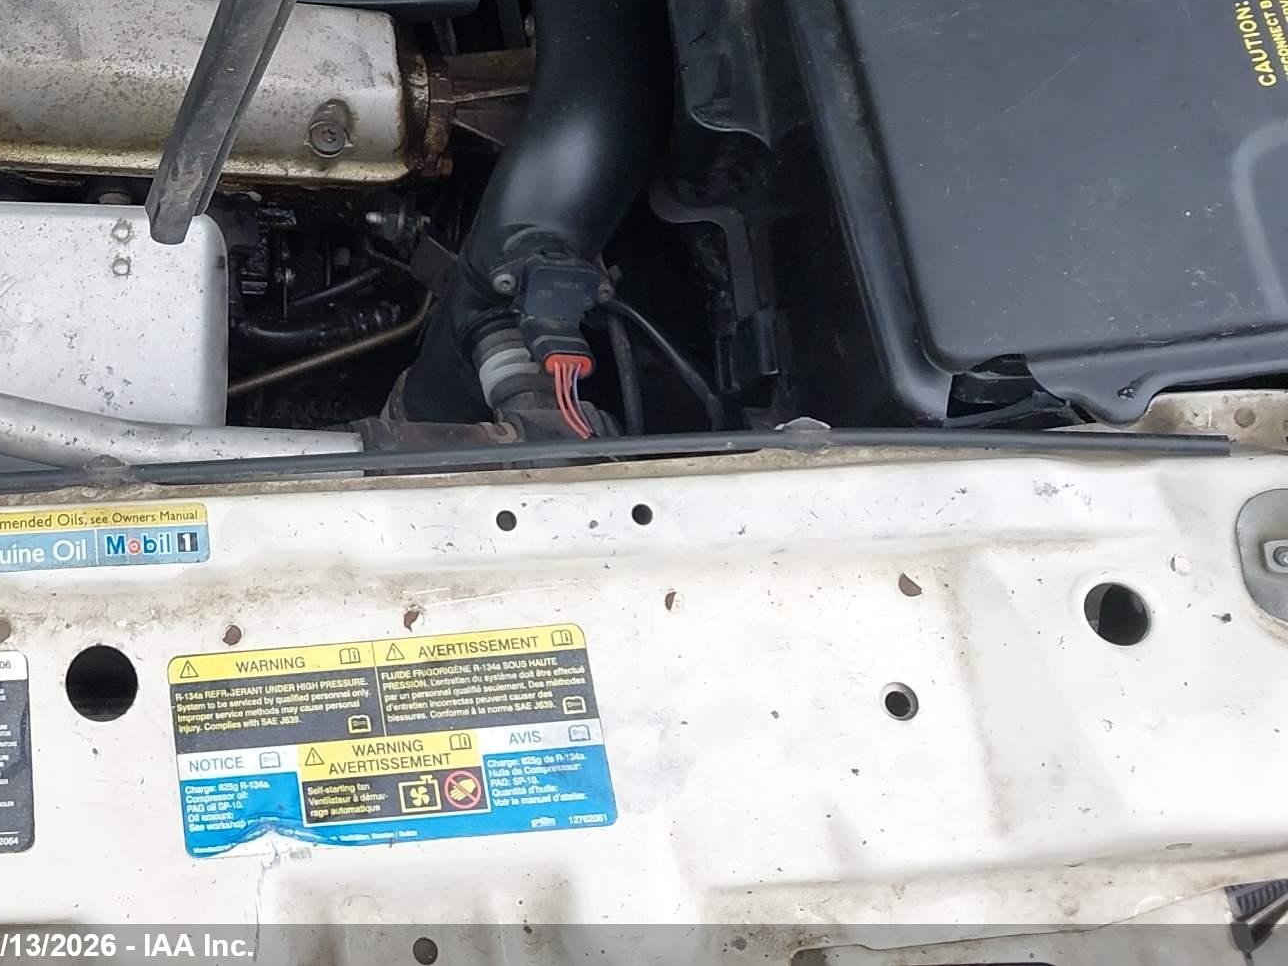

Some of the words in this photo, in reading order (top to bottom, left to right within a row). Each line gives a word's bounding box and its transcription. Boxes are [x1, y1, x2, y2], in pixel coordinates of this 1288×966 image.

[1234, 0, 1277, 86] CAUTION:
[1263, 11, 1288, 77] CONNECT
[57, 512, 89, 527] Oils,
[90, 515, 108, 525] see
[112, 512, 156, 523] Owners
[160, 509, 198, 521] Manual
[53, 539, 87, 561] Oil
[106, 532, 171, 556] Mobil
[179, 533, 195, 552] 1
[418, 636, 539, 658] AVERTISSEMENT
[236, 656, 306, 673] WARNING
[381, 670, 411, 680] FLUIDE
[413, 663, 472, 677] FRIGORIGÈNE
[473, 662, 502, 672] R-134a
[502, 660, 527, 669] SOUS
[528, 657, 558, 667] HAUTE
[472, 675, 482, 683] du
[484, 672, 517, 684] système
[519, 671, 534, 679] doit
[536, 669, 552, 677] être
[554, 666, 585, 676] effectué
[175, 692, 204, 701] R-134a
[265, 684, 295, 693] UNDER
[297, 682, 319, 691] HIGH
[320, 678, 368, 689] PRESSURE.
[385, 695, 398, 703] par
[412, 689, 452, 701] personnel
[528, 680, 545, 688] Des
[546, 677, 586, 687] méthodes
[176, 702, 206, 713] System
[207, 701, 216, 709] to
[229, 698, 262, 707] serviced
[264, 697, 274, 706] by
[275, 694, 310, 706] qualified
[311, 691, 351, 703] personnel
[476, 694, 508, 706] peuvent
[537, 690, 553, 698] des
[215, 710, 244, 719] service
[245, 707, 280, 716] methods
[281, 707, 298, 715] may
[325, 700, 360, 711] personal
[430, 709, 469, 719] Conforme
[515, 703, 533, 711] SAE
[203, 721, 242, 733] Complies
[243, 719, 260, 727] with
[261, 718, 279, 726] SAE
[509, 730, 541, 744] AVIS
[352, 739, 424, 756] WARNING
[189, 756, 244, 772] NOTICE
[329, 752, 452, 775] AVERTISSEMENT
[543, 755, 555, 763] de
[489, 768, 510, 777] Huile
[512, 767, 522, 775] de
[307, 784, 355, 795] Self-starting
[357, 783, 370, 791] fan
[186, 793, 235, 803] Compressor
[308, 795, 351, 805] Ventilateur
[353, 793, 359, 802] à
[360, 792, 389, 801] démar-
[493, 797, 510, 806] Voir
[511, 797, 520, 805] le
[521, 795, 552, 804] manuel
[187, 804, 205, 813] PAG
[310, 809, 329, 818] rage
[330, 804, 381, 814] automatique
[188, 814, 200, 823] Oil
[189, 823, 205, 833] See
[206, 820, 246, 830] workshop
